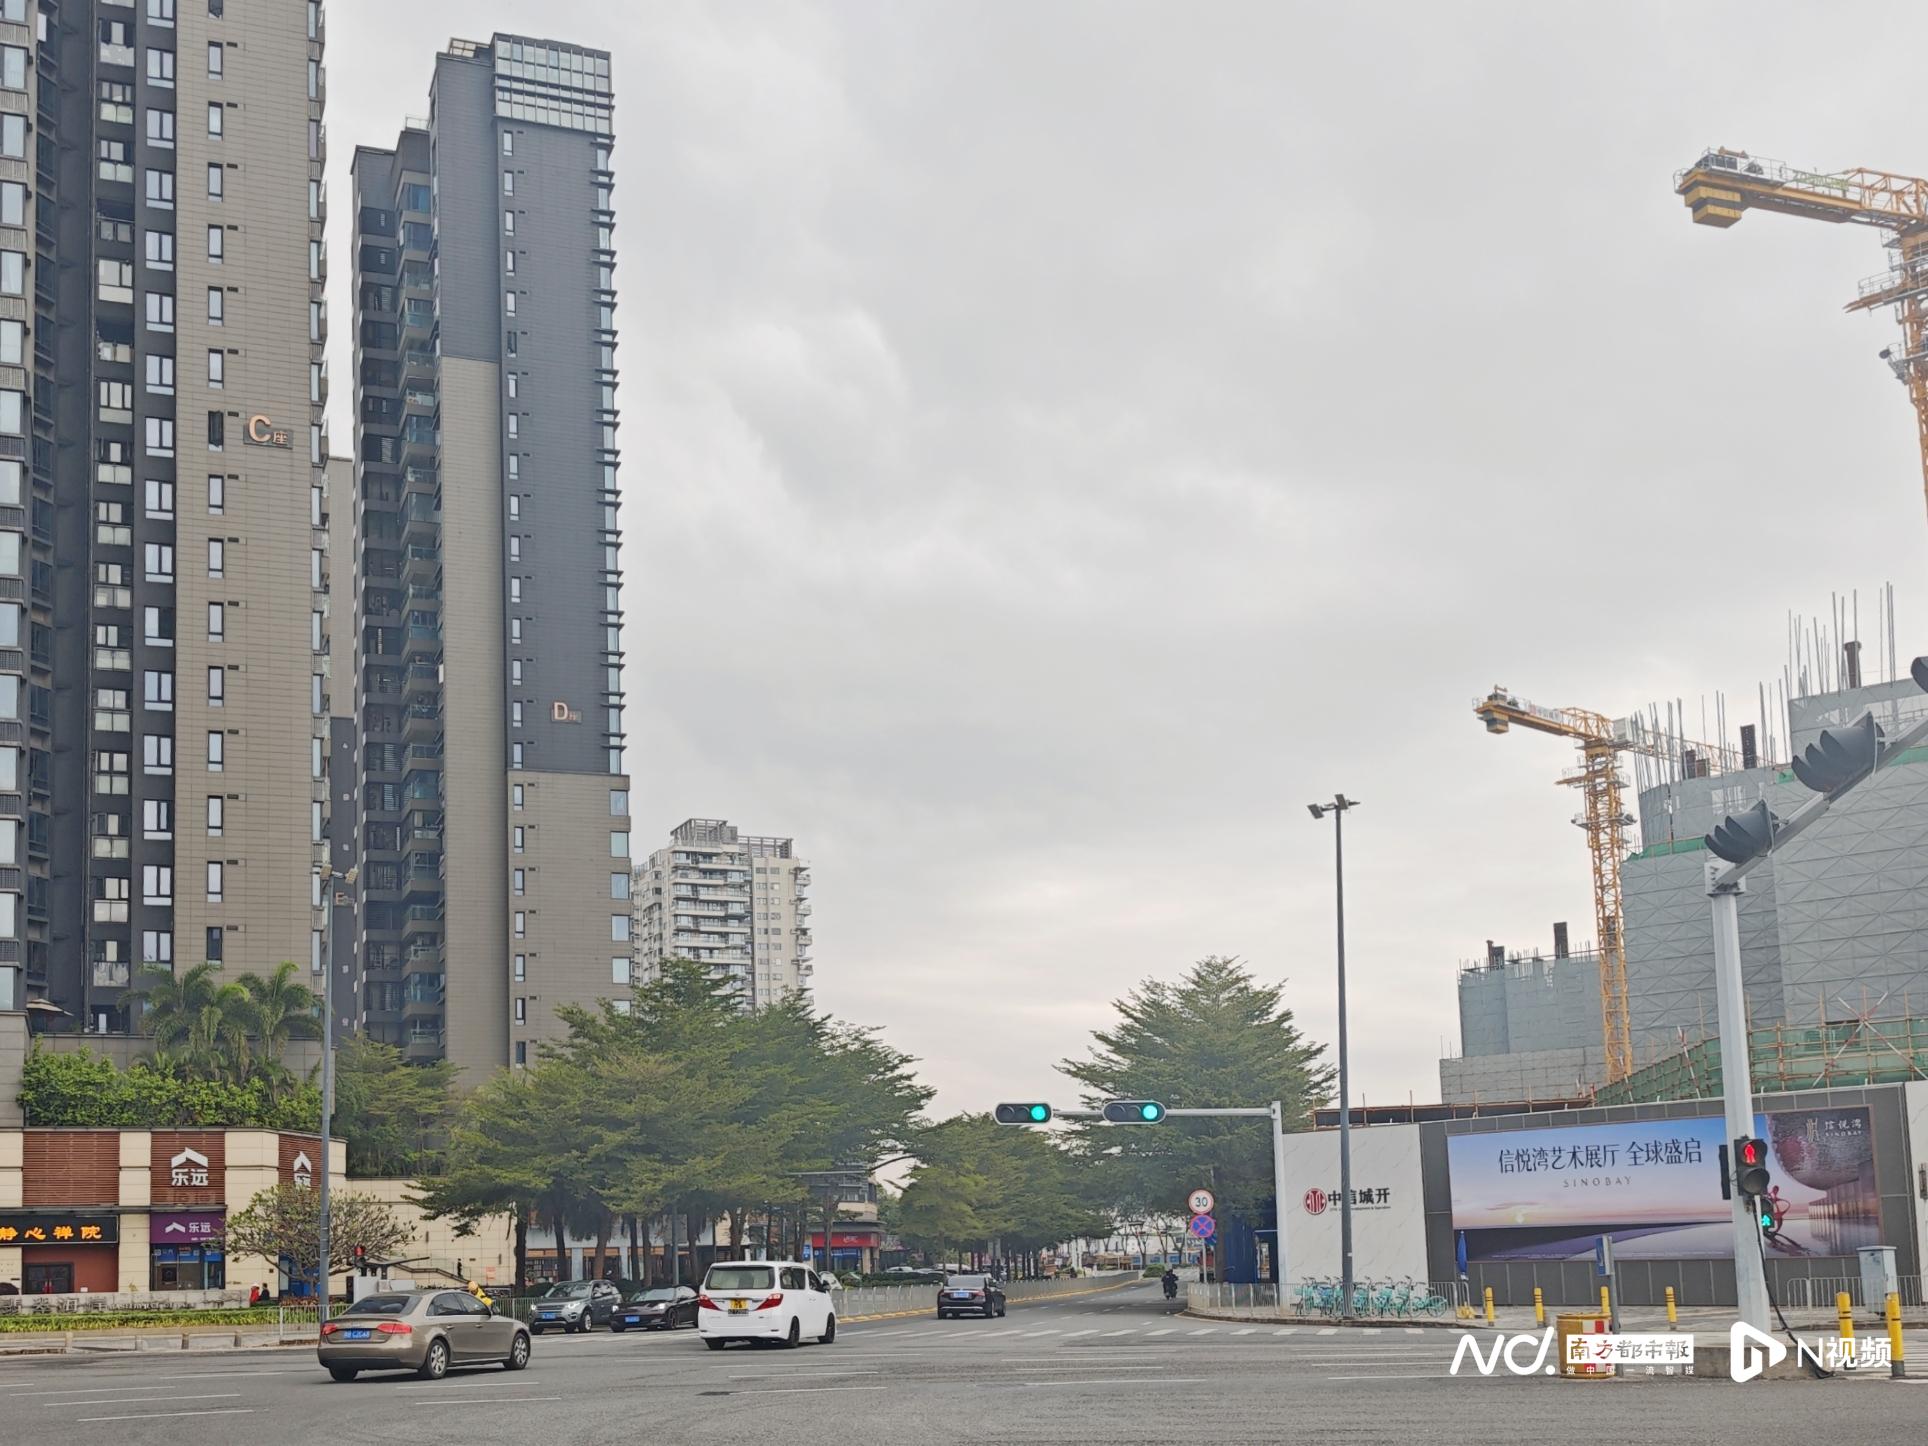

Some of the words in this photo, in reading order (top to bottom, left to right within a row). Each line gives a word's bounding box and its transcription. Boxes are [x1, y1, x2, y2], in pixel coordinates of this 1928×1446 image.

[1499, 1144, 1621, 1173] 信悦湾艺术展厅
[1626, 1137, 1702, 1167] 全球盛启
[171, 1168, 209, 1186] 乐远
[1563, 1176, 1632, 1187] SINOBAY
[1195, 1196, 1208, 1207] 30
[188, 1222, 211, 1233] 乐远
